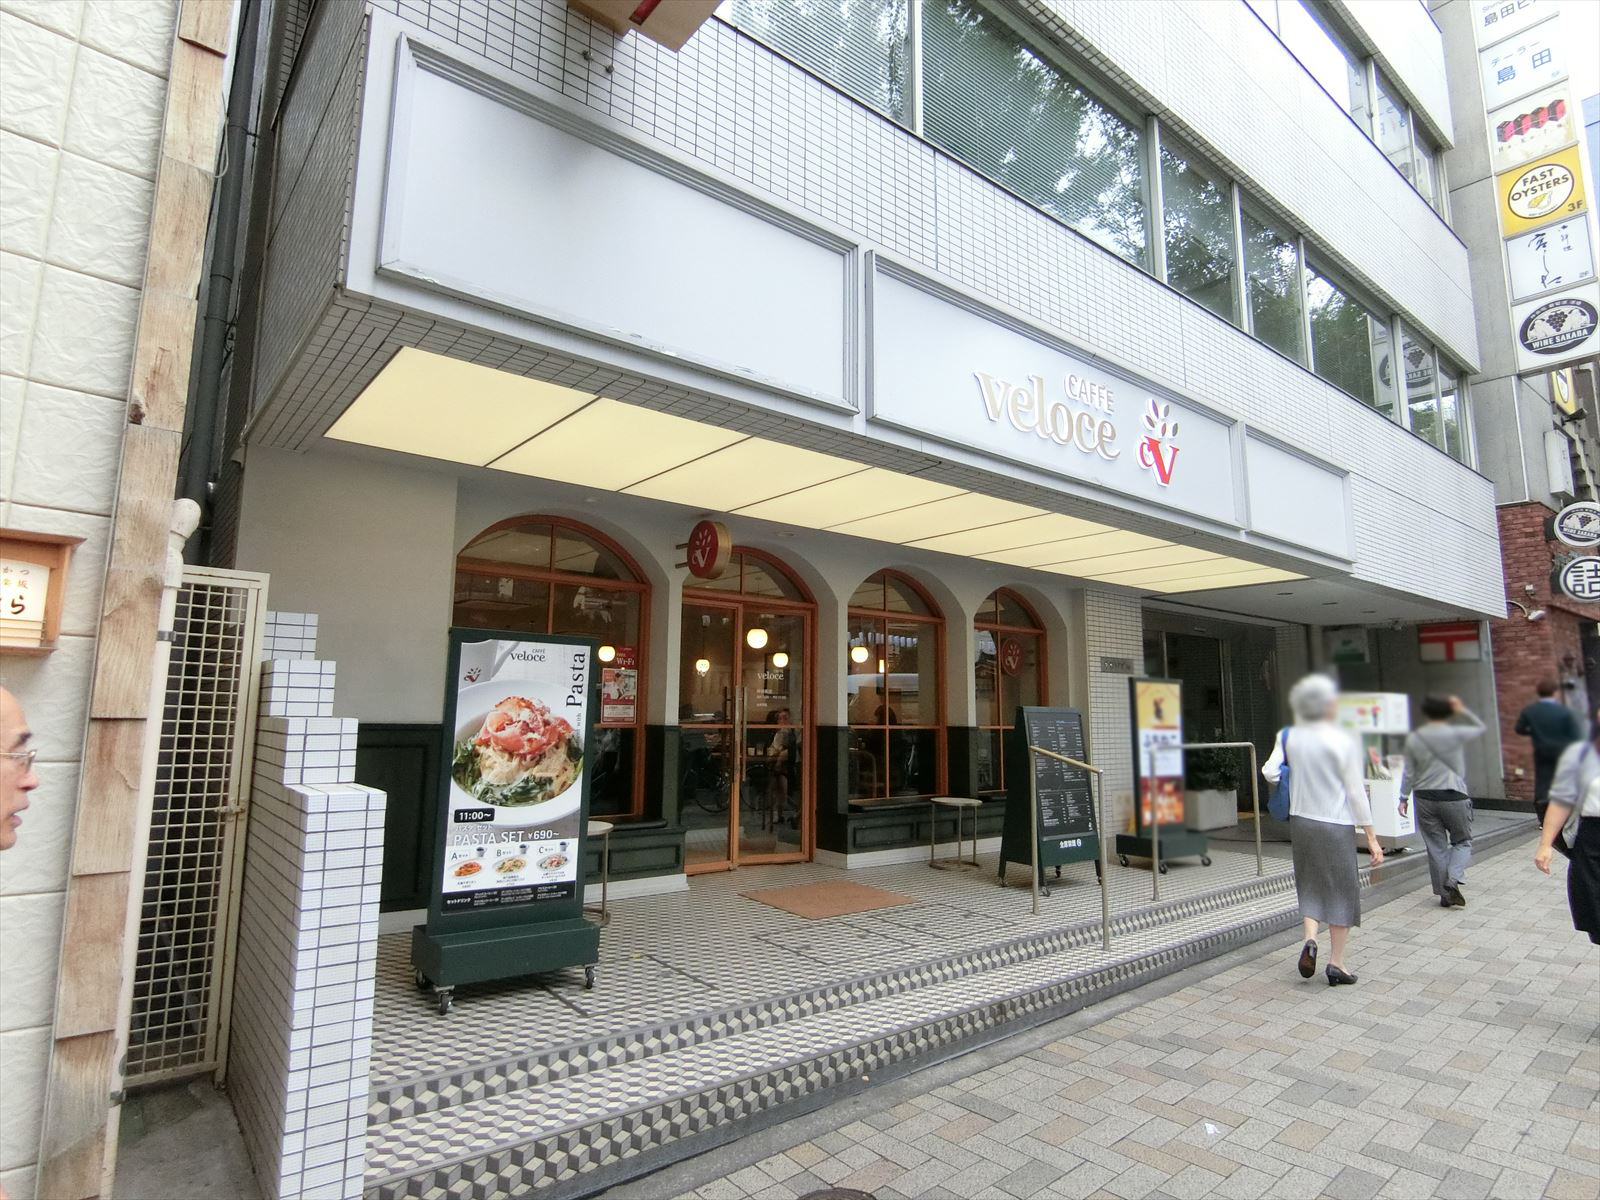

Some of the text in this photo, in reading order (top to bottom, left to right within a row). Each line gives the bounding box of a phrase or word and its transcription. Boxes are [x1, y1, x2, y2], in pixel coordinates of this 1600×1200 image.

[1521, 167, 1555, 187] FAST
[1511, 174, 1570, 202] OYSTERS
[1567, 199, 1584, 212] 3F
[1531, 329, 1588, 350] WINE SAKABA
[974, 371, 1120, 461] veloce
[1571, 563, 1600, 594] 詰
[510, 651, 546, 662] veloce
[566, 652, 586, 708] Pasta
[757, 671, 784, 681] veloce
[453, 831, 525, 846] PASTA SET
